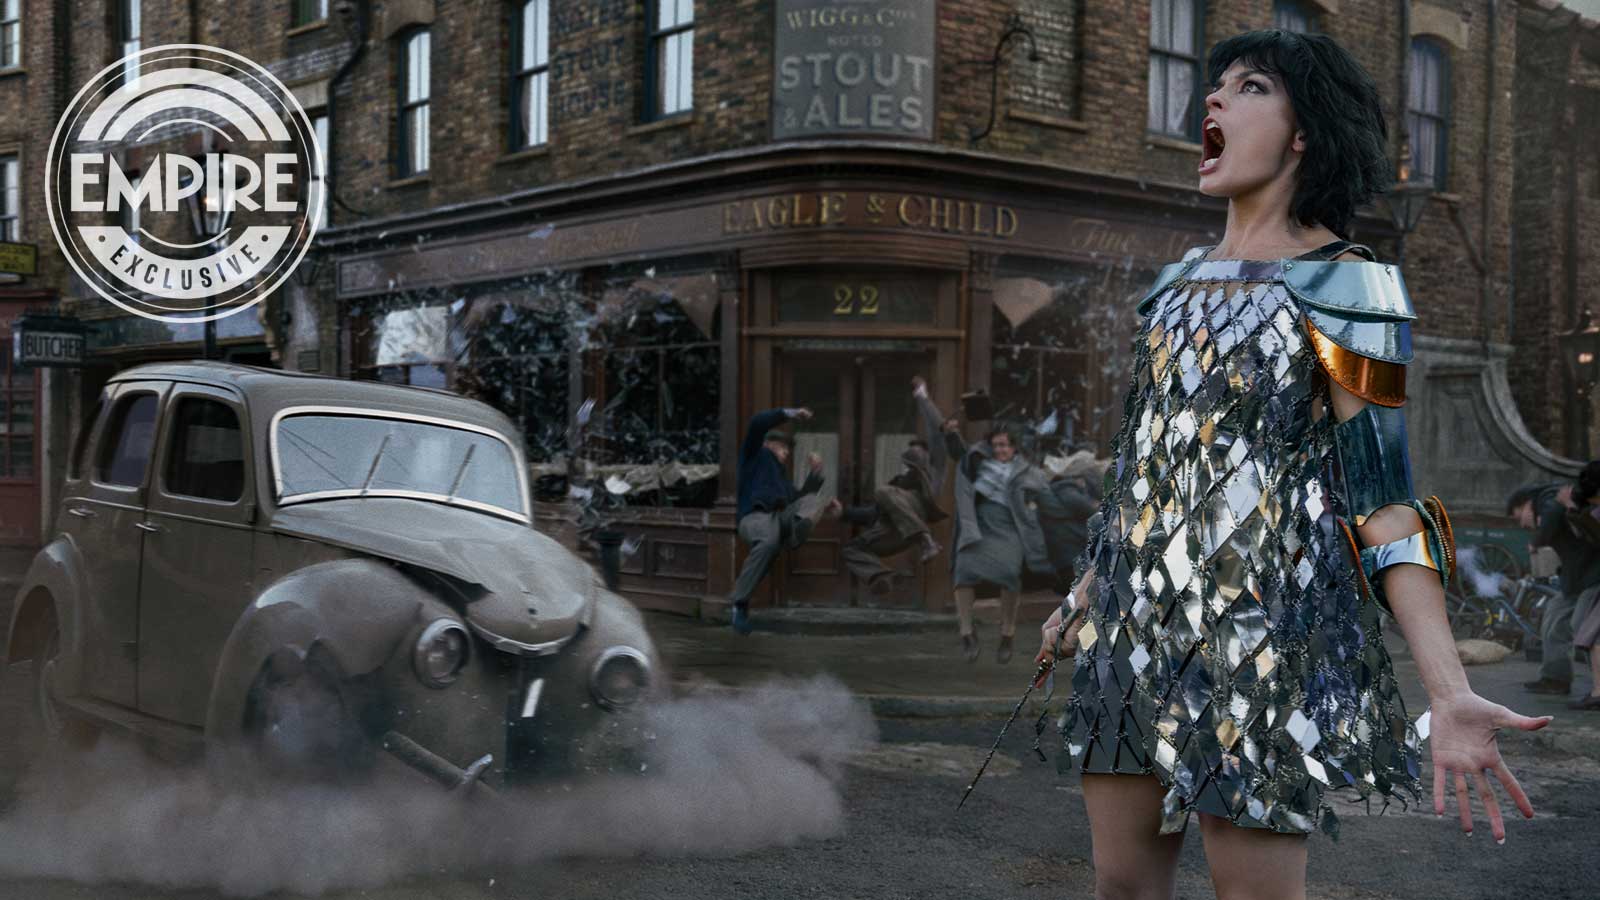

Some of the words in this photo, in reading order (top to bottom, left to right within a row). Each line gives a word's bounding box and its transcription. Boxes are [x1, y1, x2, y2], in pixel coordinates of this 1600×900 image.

[780, 51, 930, 91] STOUT
[784, 107, 798, 129] &
[803, 93, 923, 130] ALES
[721, 191, 848, 234] EAGLE
[865, 193, 885, 223] &
[897, 194, 1018, 238] CHILD
[833, 284, 879, 315] 22
